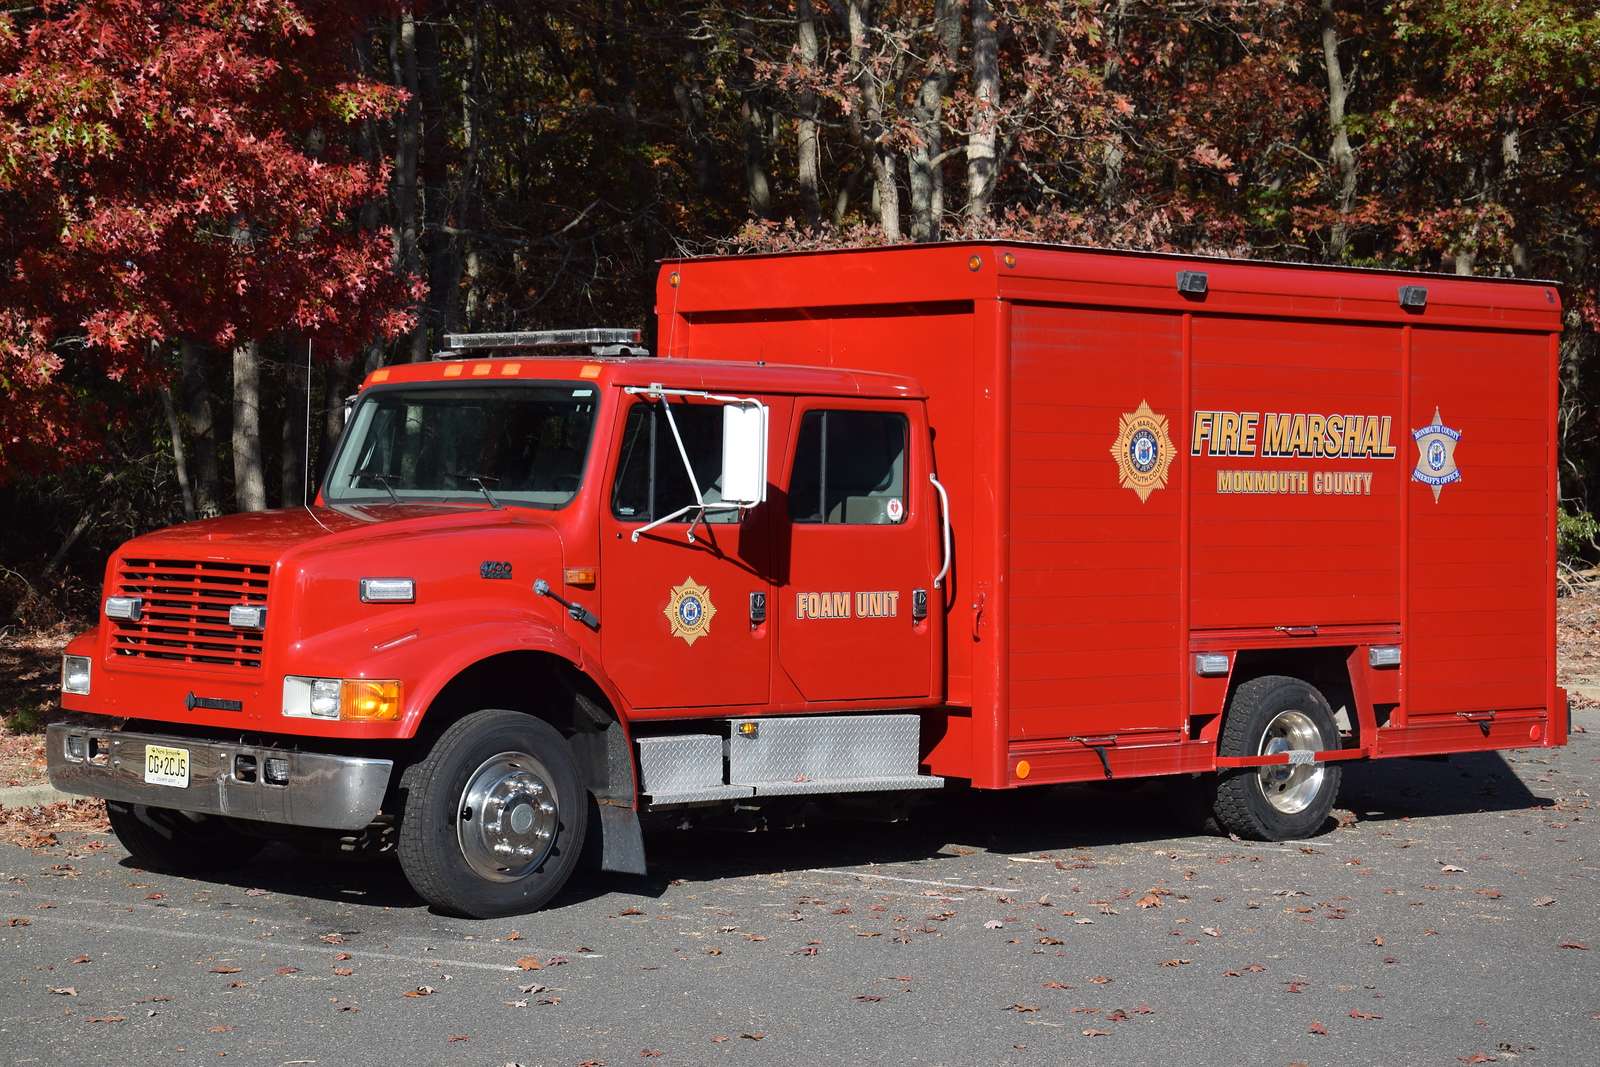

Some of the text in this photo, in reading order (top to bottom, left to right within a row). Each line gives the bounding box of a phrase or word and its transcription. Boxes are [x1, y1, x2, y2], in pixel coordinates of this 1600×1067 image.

[1126, 420, 1161, 440] FIRE MARSHAL
[1191, 410, 1259, 457] FIRE
[1262, 413, 1396, 459] MARSHAL
[1414, 425, 1460, 440] MONMOUTH COUNTY
[1123, 451, 1165, 482] MONMOUTH COUNTY
[1413, 470, 1460, 485] SHERIFF'S OFFICE
[1217, 470, 1373, 495] MONMOUTH COUNTY
[796, 591, 899, 619] FOAM UNIT
